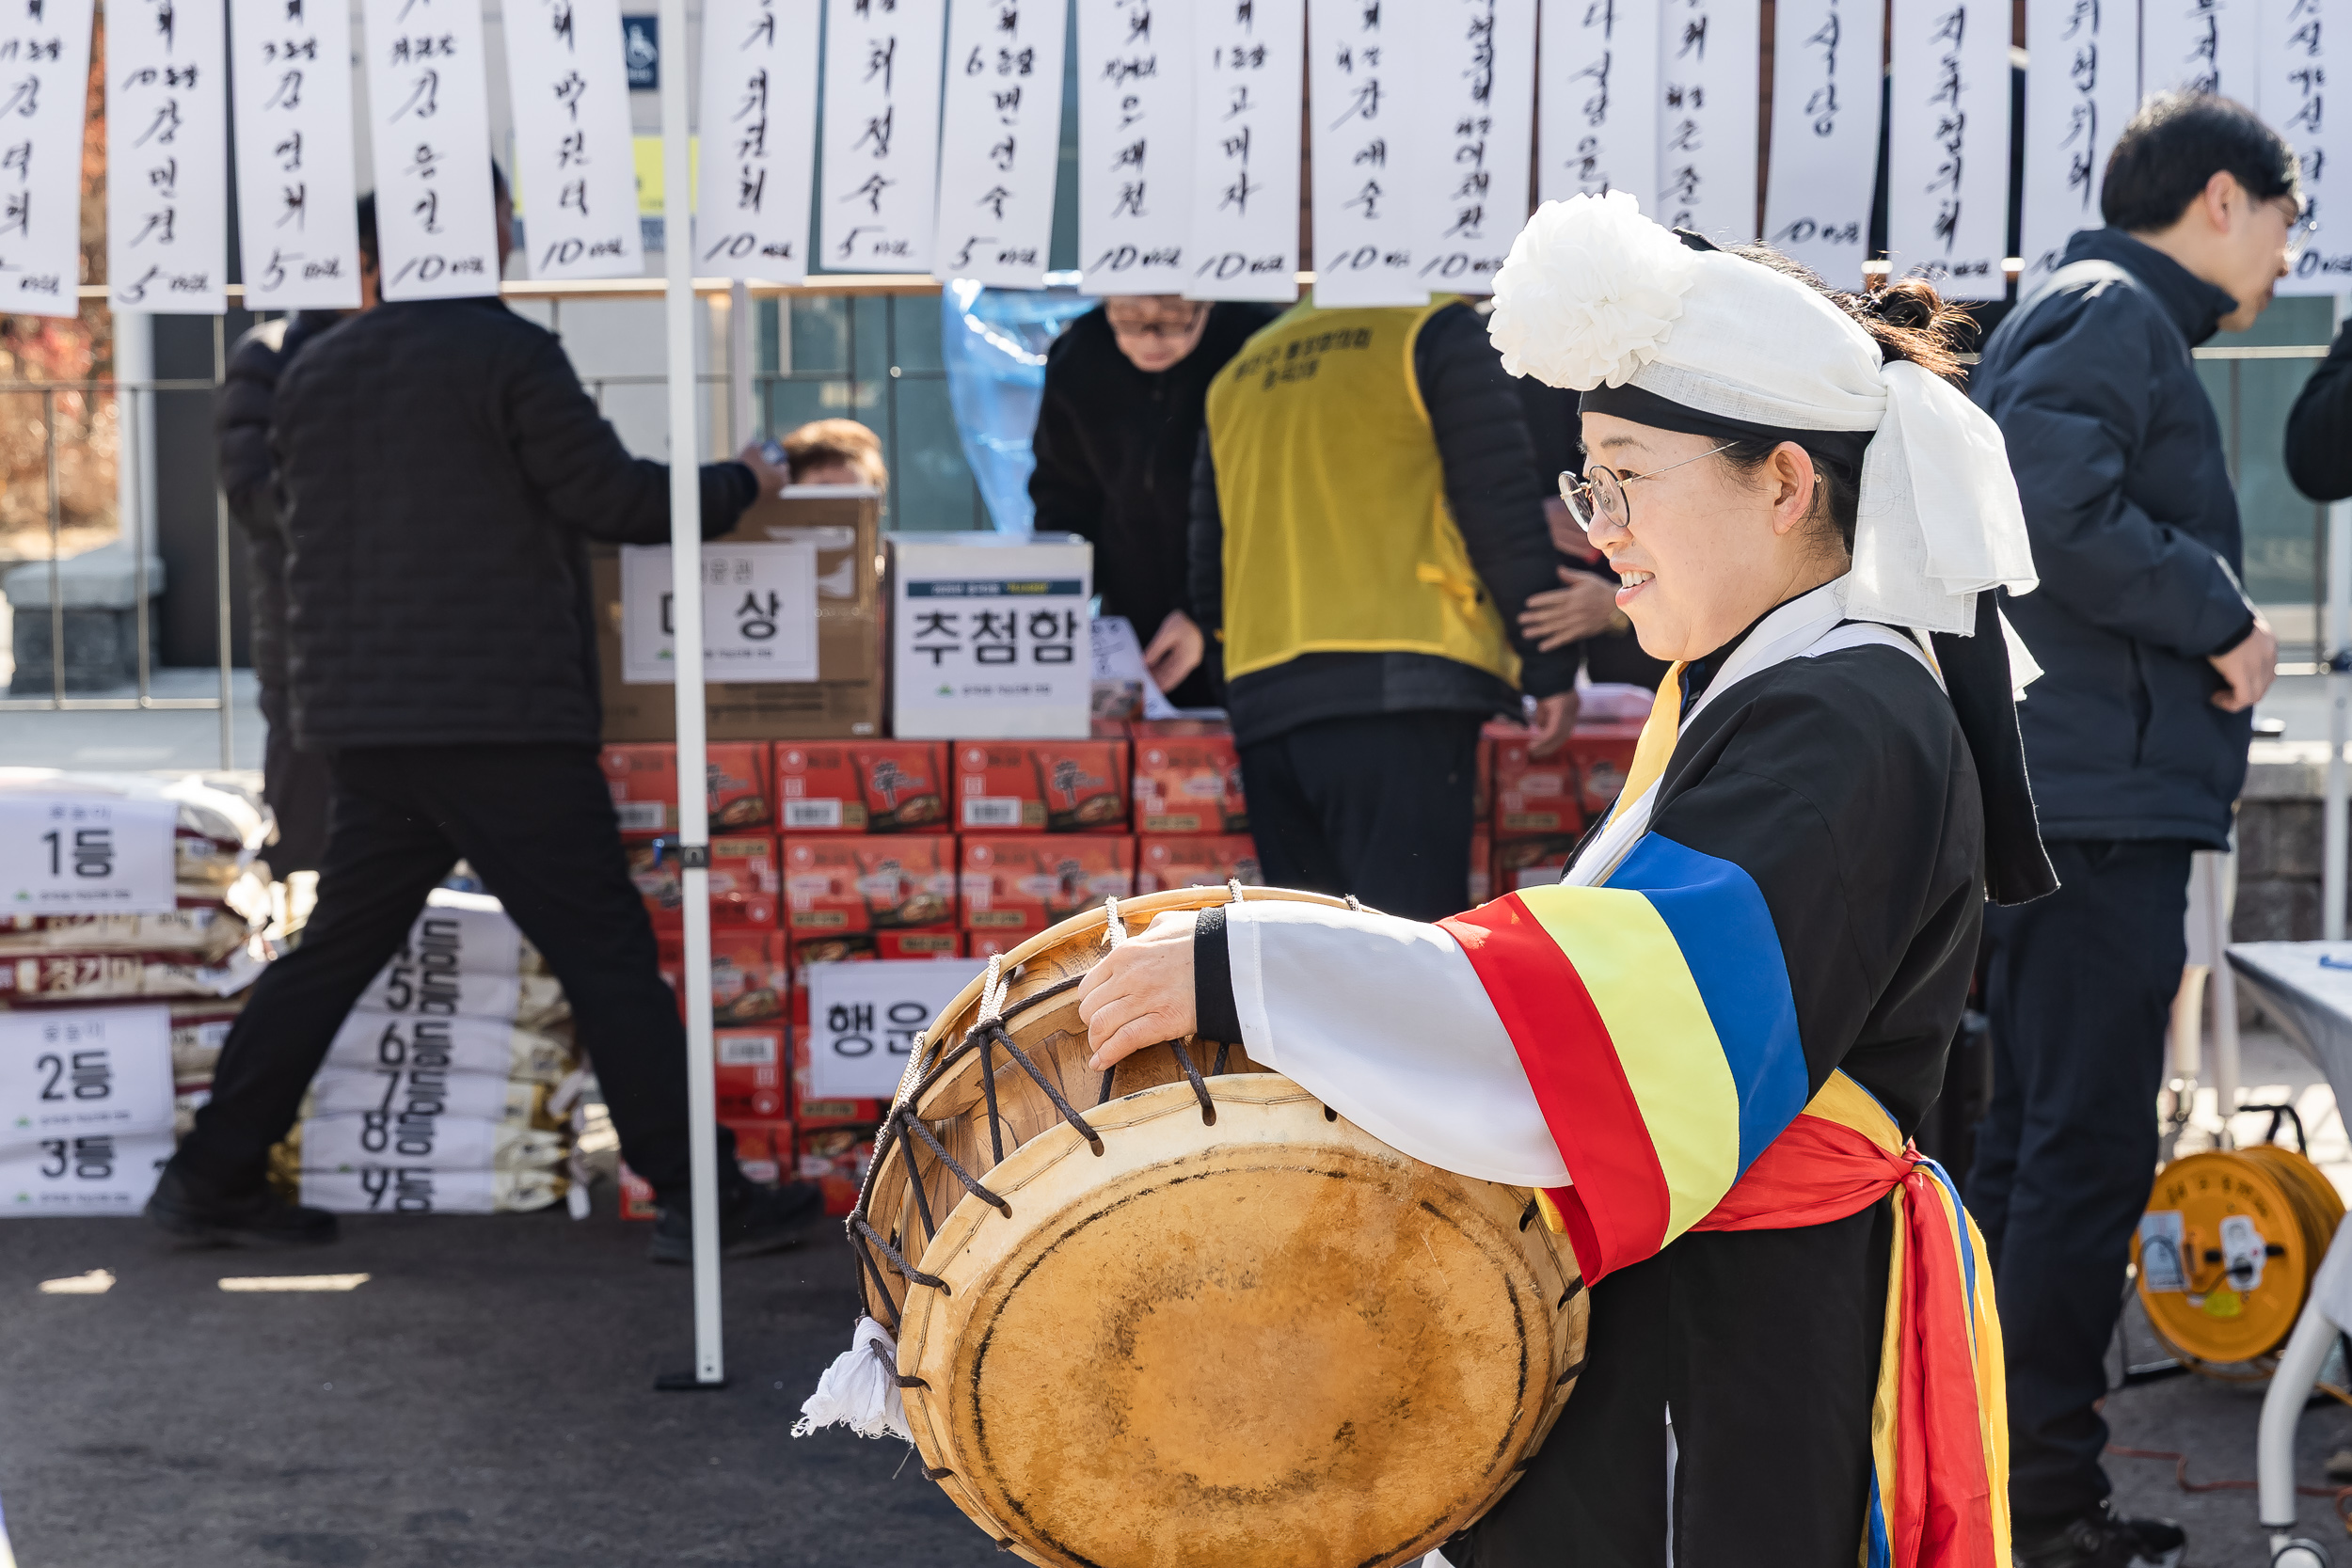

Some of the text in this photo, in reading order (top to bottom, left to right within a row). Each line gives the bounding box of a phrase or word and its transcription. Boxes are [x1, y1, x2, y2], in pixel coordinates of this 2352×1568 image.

[914, 608, 1078, 665] 추첨함
[41, 829, 114, 878] 1등
[37, 1051, 111, 1101] 2등
[40, 1134, 114, 1179] 3등
